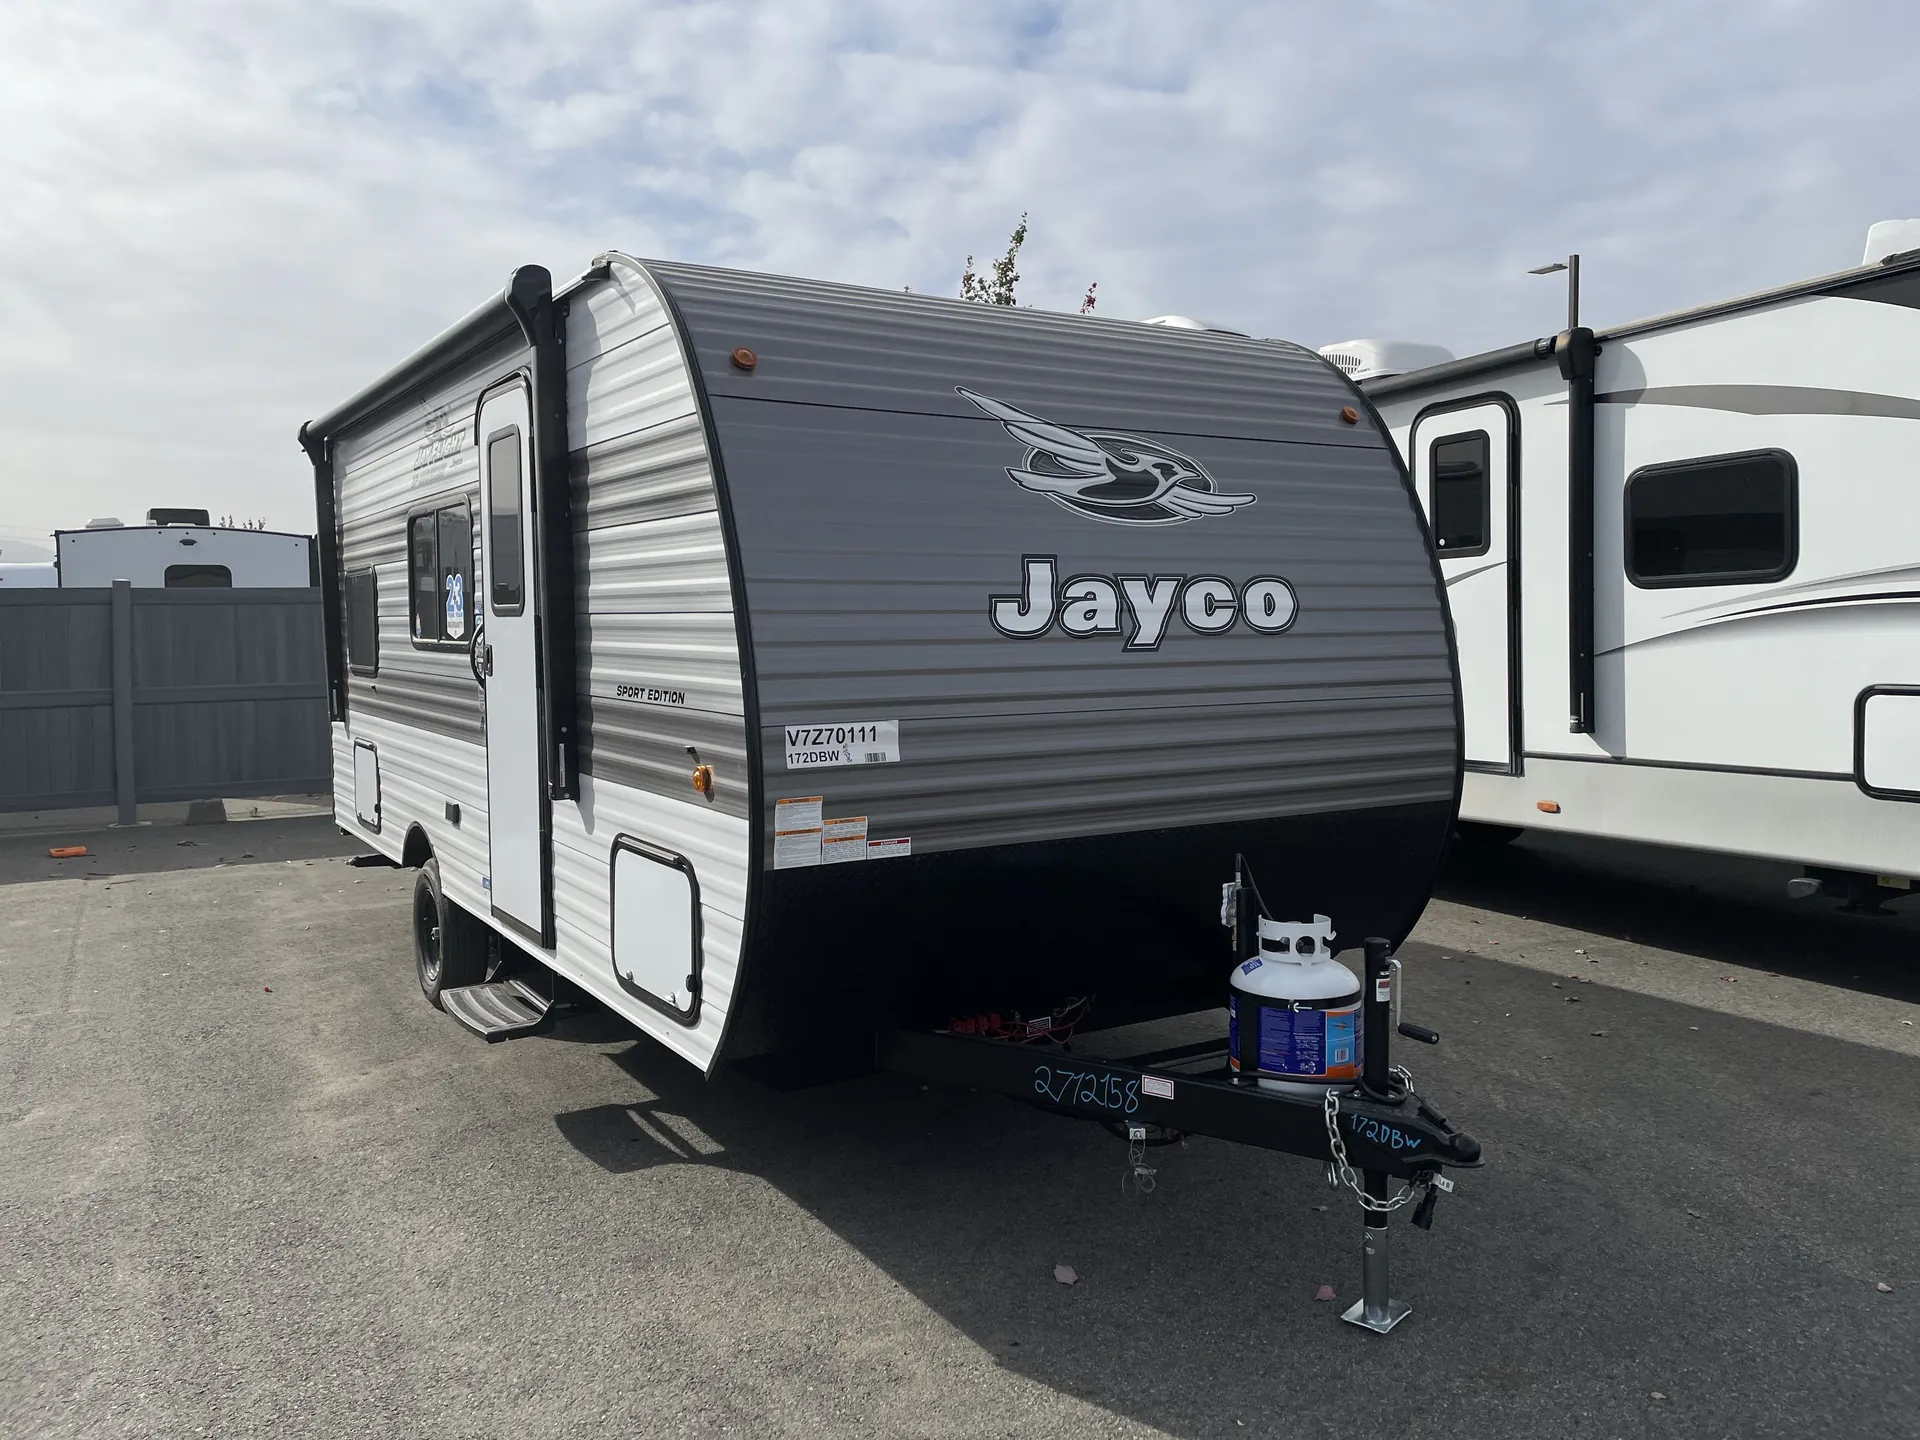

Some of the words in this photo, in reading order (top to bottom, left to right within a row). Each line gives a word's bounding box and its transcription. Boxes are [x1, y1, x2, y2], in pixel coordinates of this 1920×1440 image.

[988, 554, 1299, 652] Jayco
[616, 684, 645, 699] SPORT
[647, 688, 685, 704] EDITION
[786, 725, 876, 747] V7Z70111
[787, 750, 840, 765] 172DBW
[1034, 1065, 1140, 1113] 2712158
